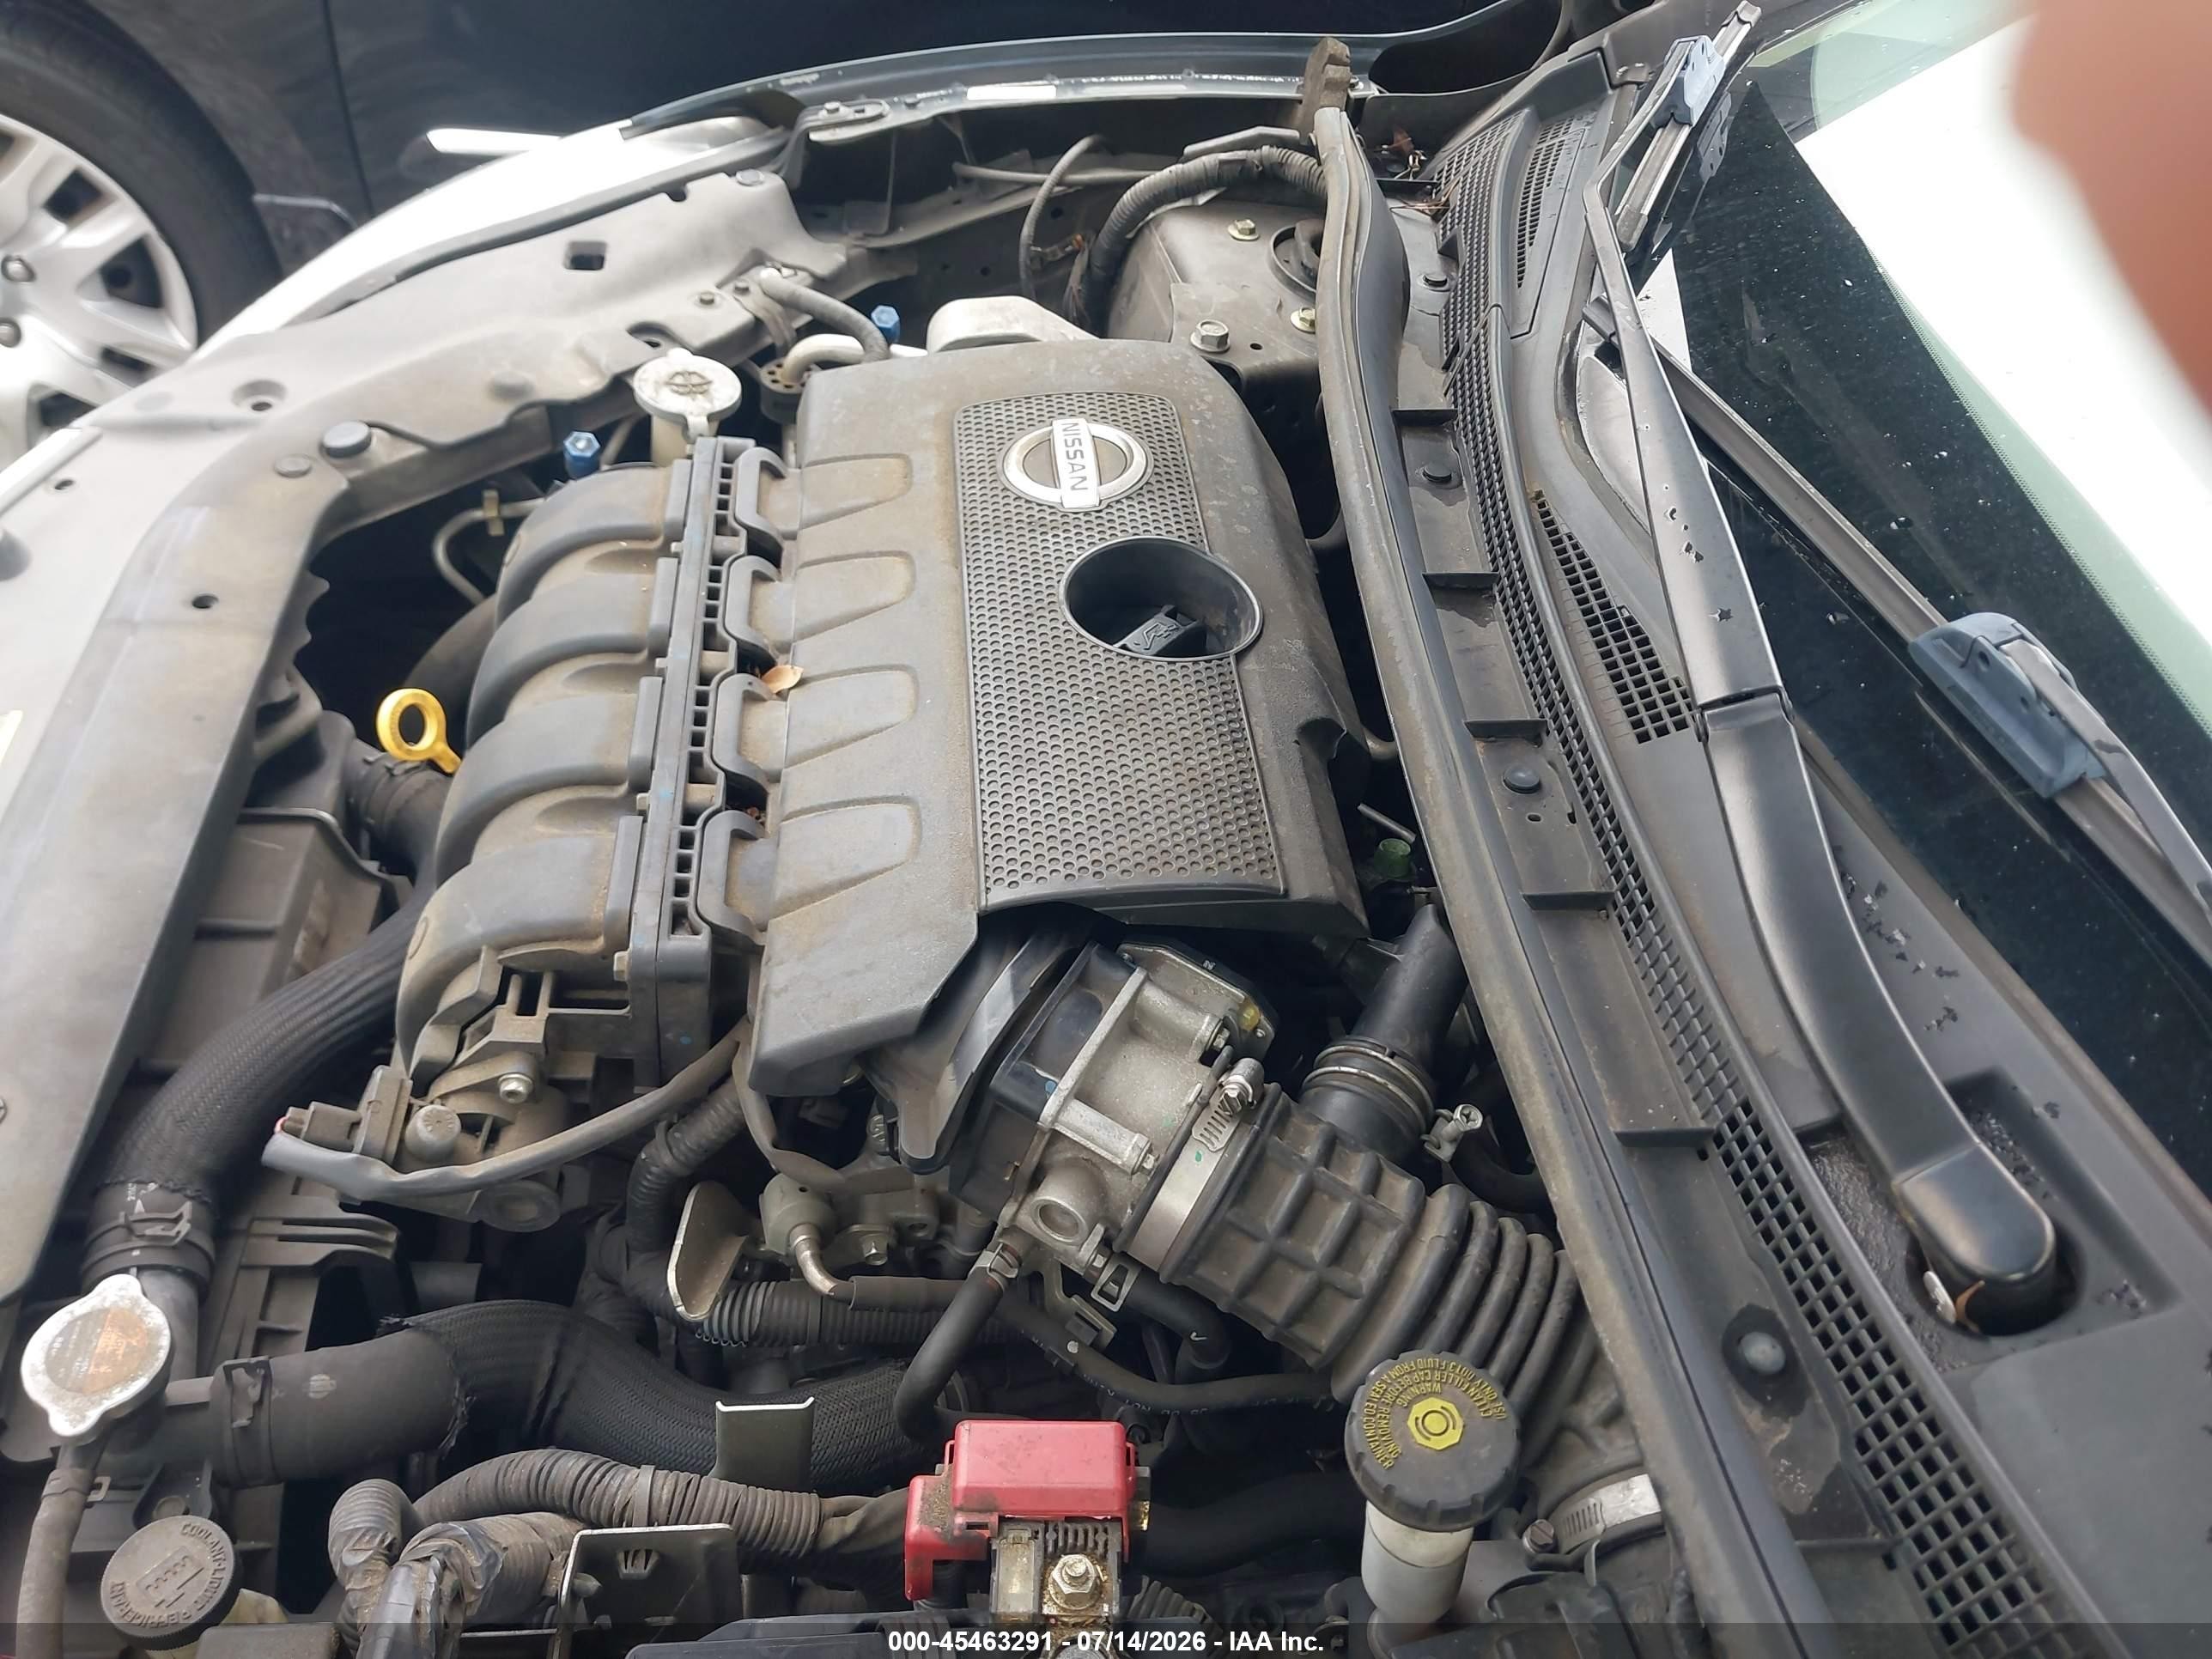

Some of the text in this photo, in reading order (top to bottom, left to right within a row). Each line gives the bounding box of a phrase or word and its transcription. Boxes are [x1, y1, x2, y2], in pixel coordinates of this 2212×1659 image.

[1061, 422, 1088, 491] NISSAN
[1389, 1361, 1416, 1379] FROM
[1416, 1358, 1447, 1370] FLUID
[1381, 1374, 1391, 1383] A
[1414, 1370, 1431, 1382] CAP
[1435, 1370, 1470, 1391] FILLER
[1382, 1375, 1412, 1407] BEFORE
[1396, 1381, 1441, 1407] WARNING
[1377, 1407, 1401, 1458] REMOVING
